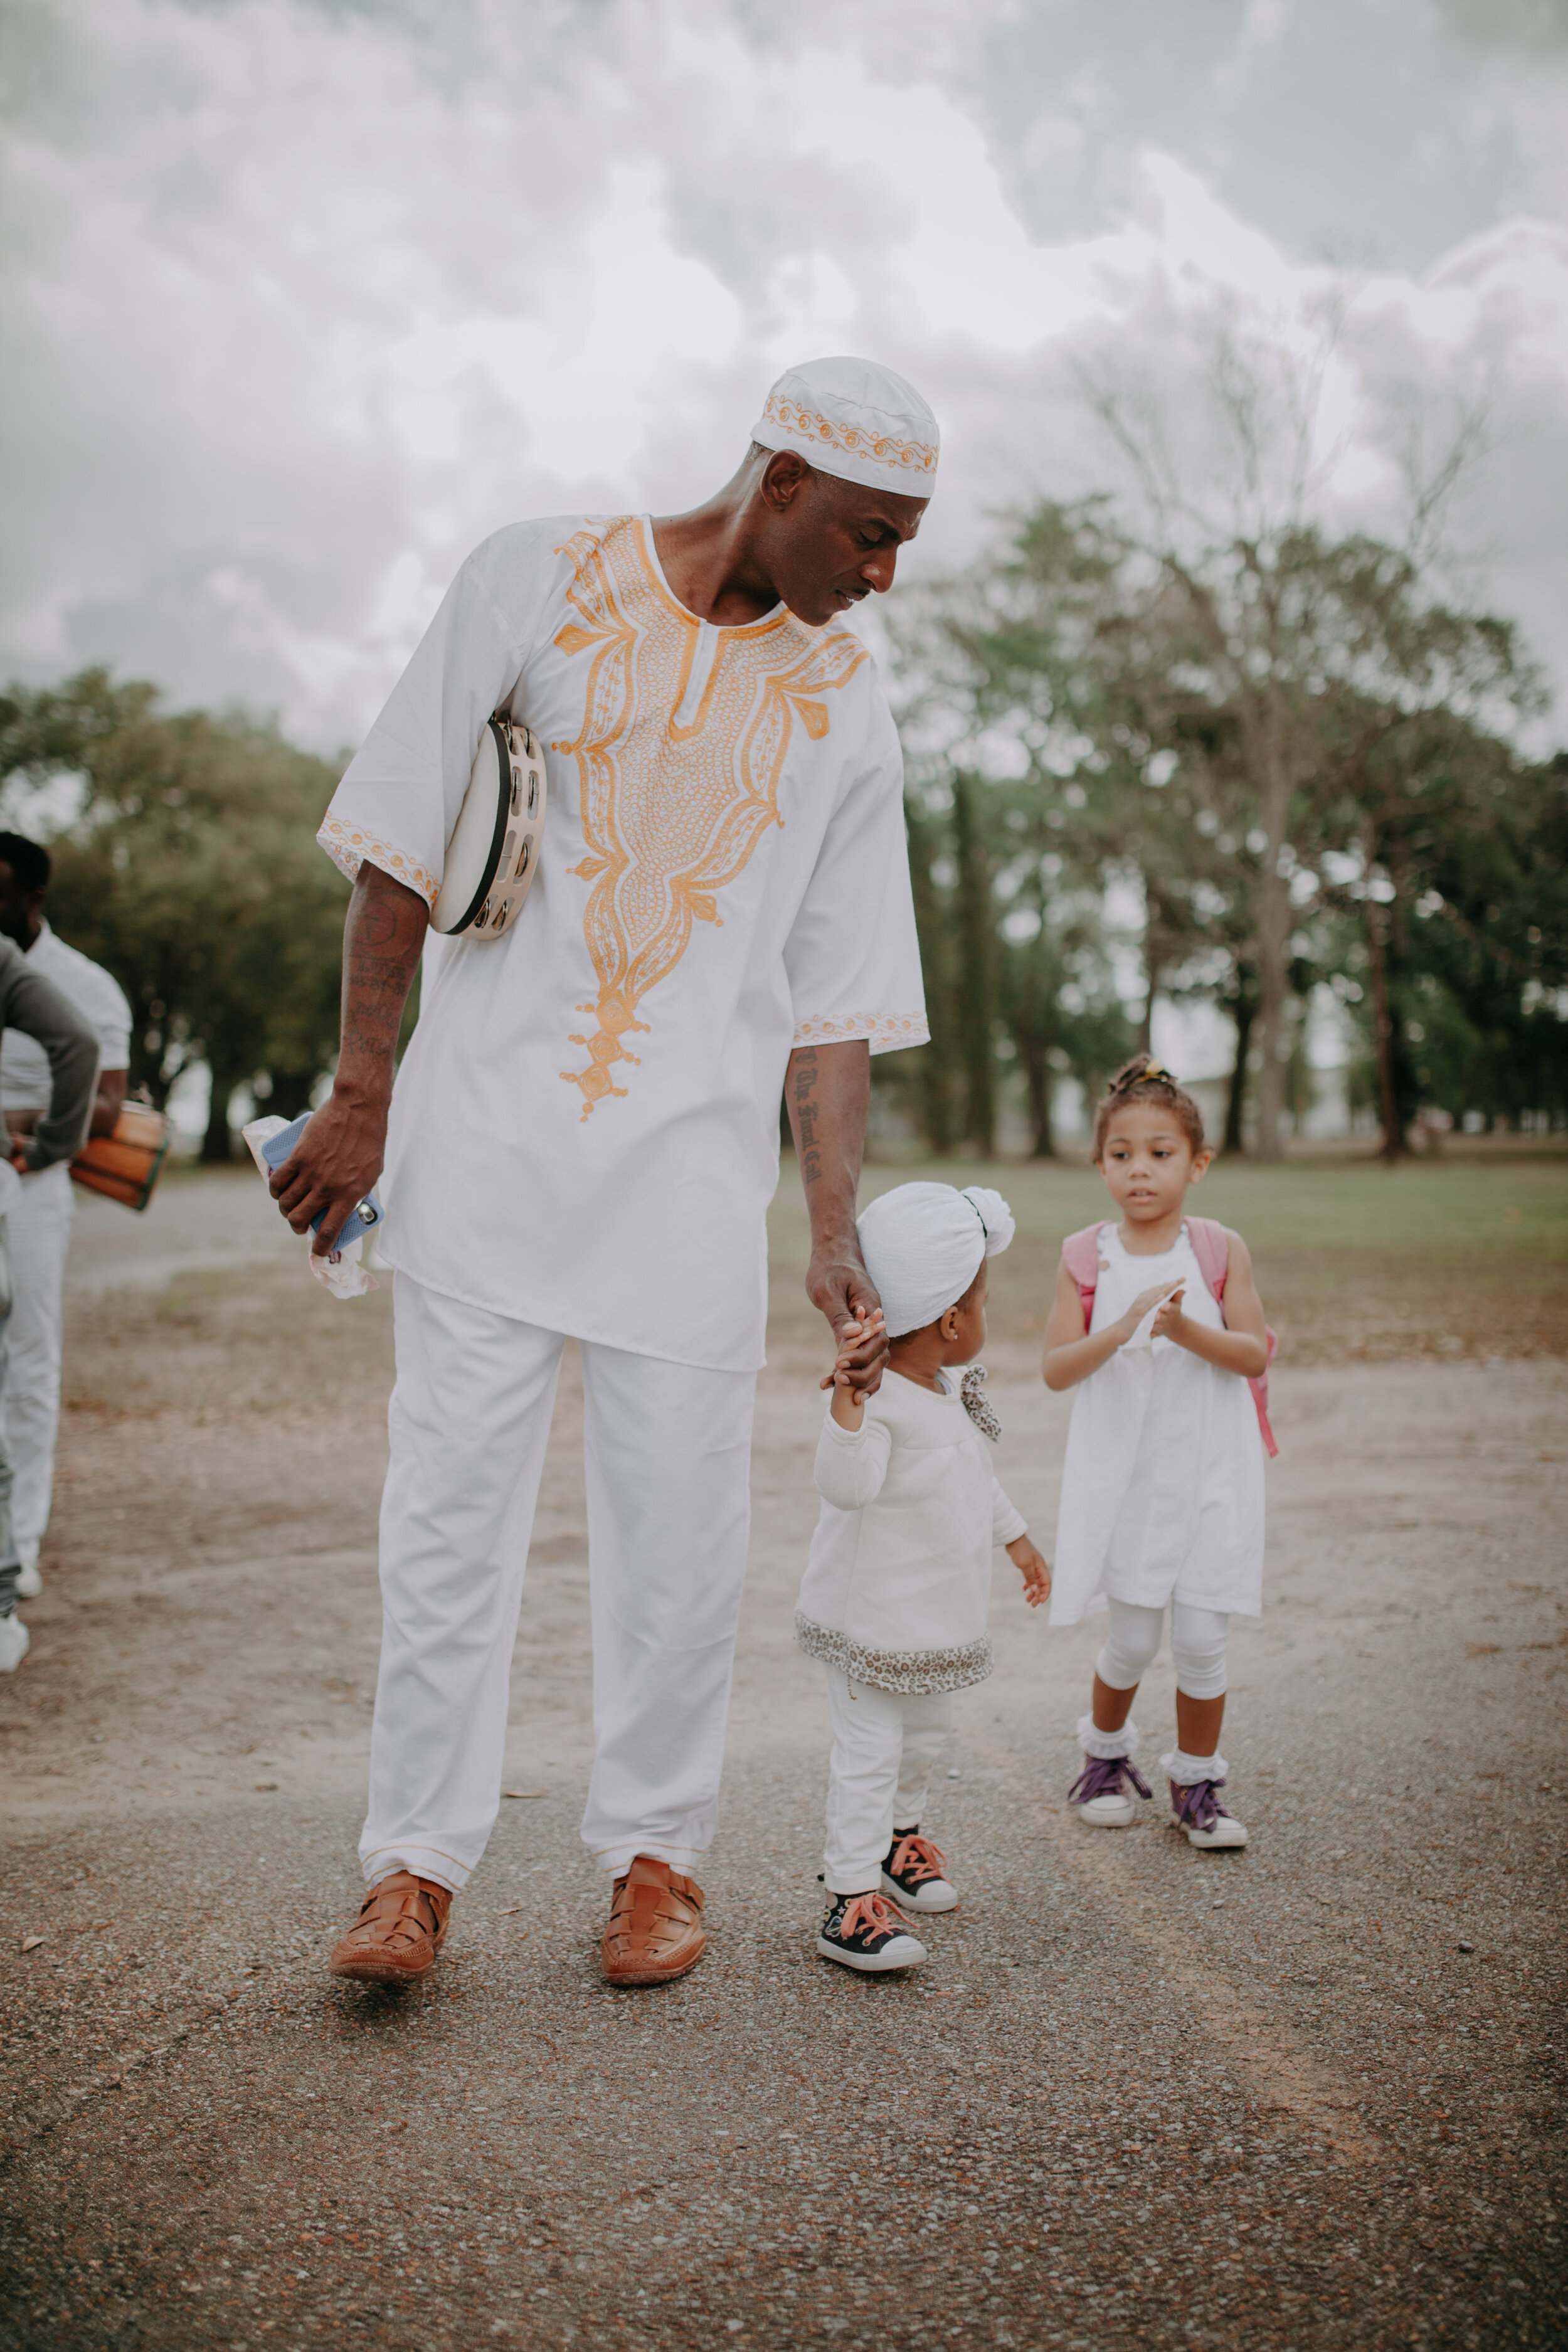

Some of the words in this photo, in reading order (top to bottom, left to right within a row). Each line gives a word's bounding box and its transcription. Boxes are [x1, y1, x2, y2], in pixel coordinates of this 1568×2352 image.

[794, 1068, 817, 1101] The
[798, 1102, 819, 1151] Final
[804, 1152, 820, 1185] Call
